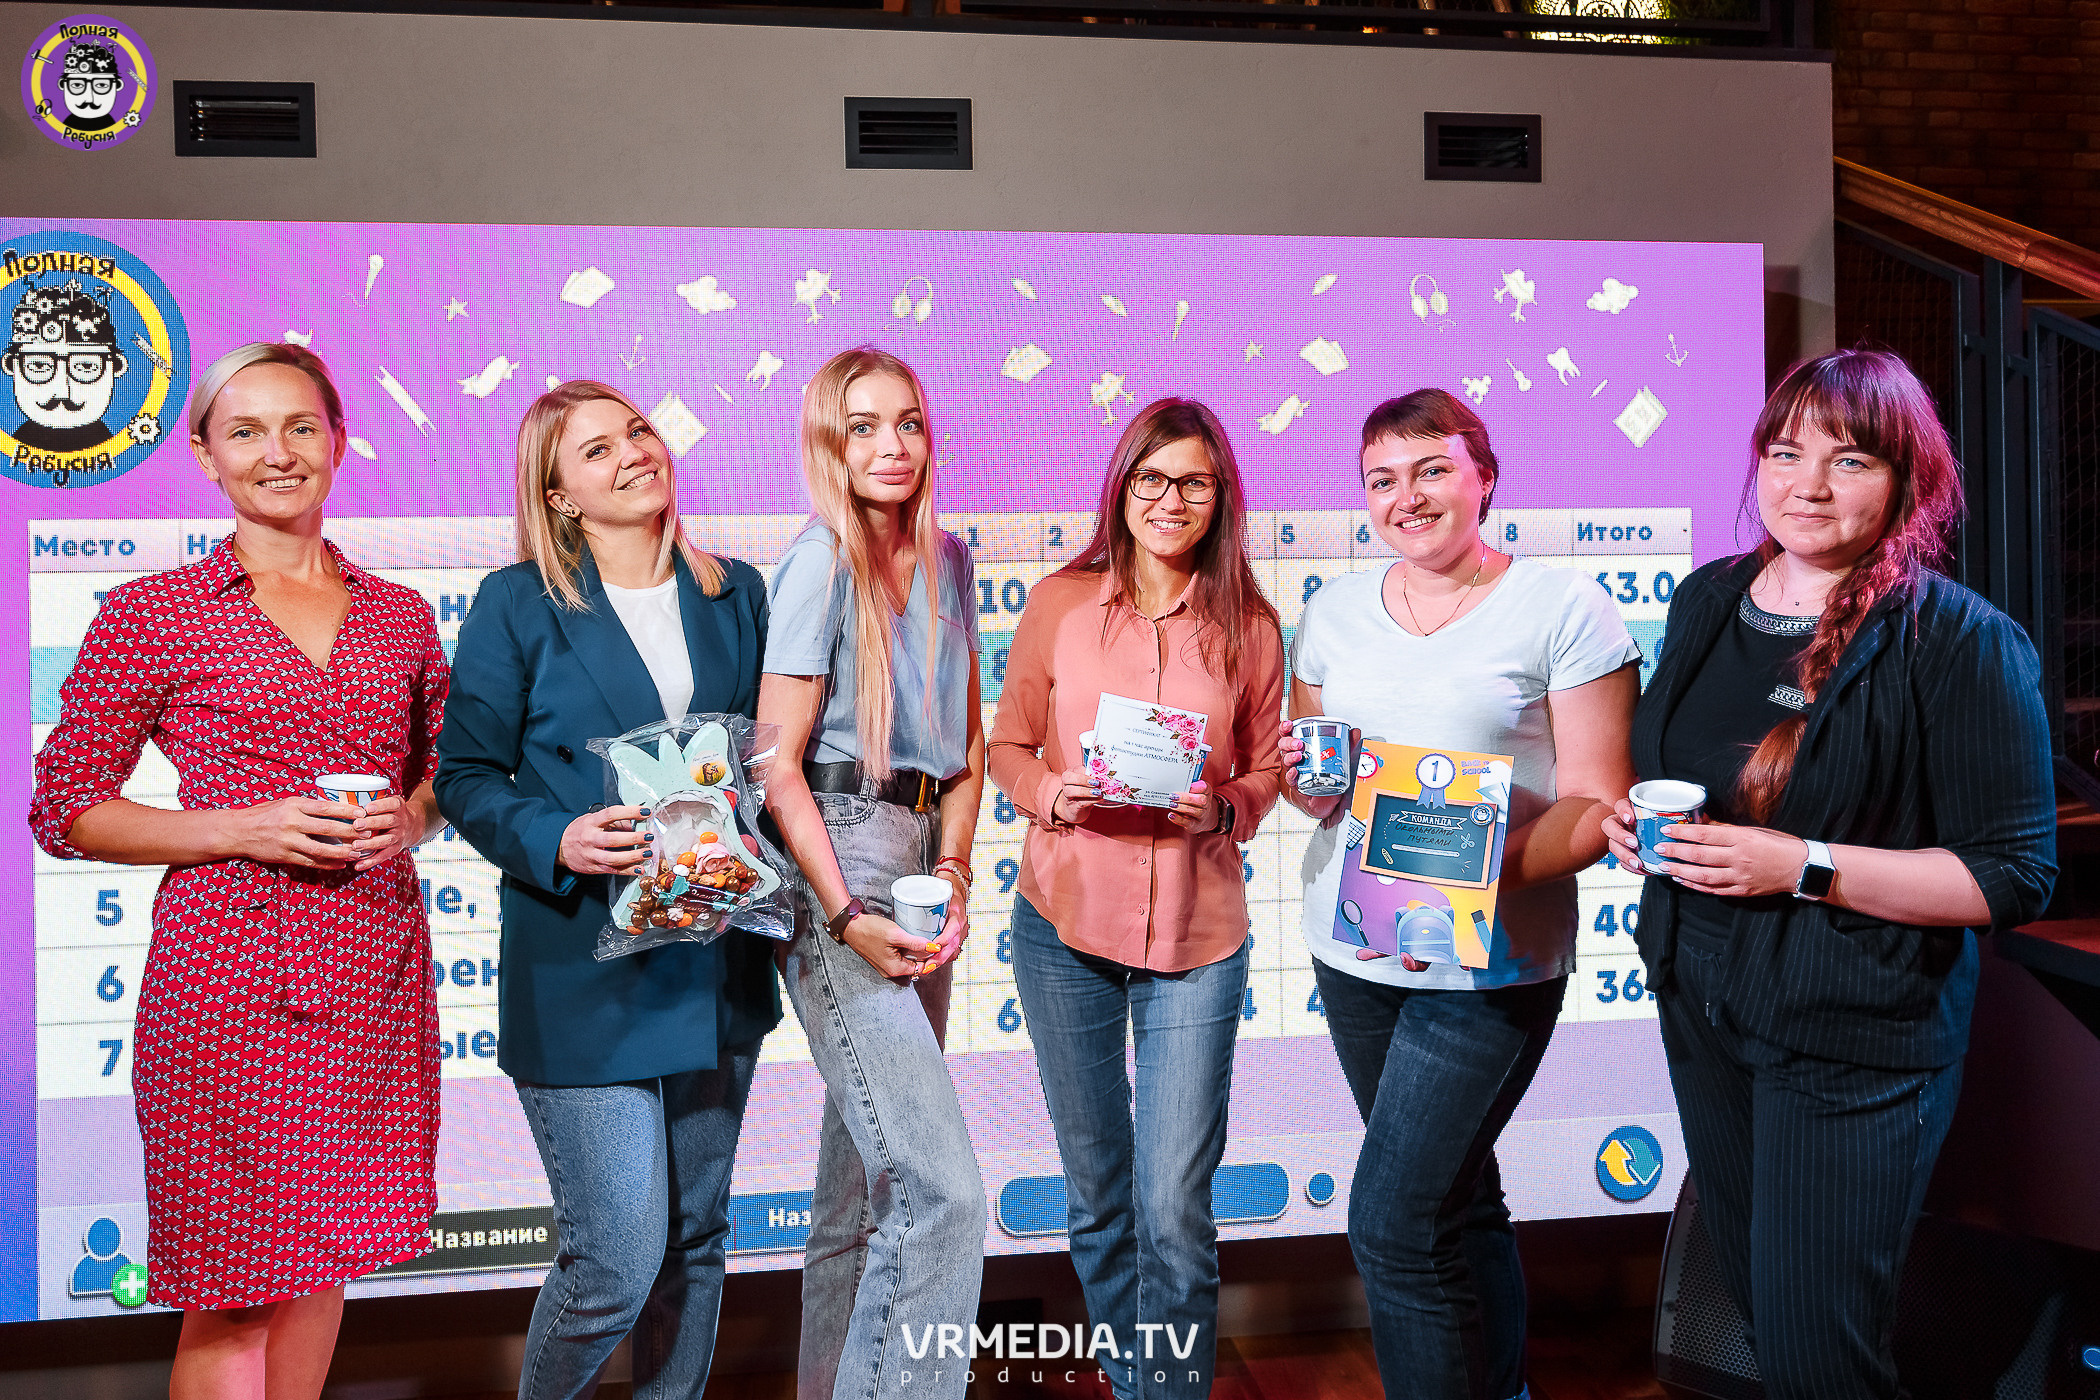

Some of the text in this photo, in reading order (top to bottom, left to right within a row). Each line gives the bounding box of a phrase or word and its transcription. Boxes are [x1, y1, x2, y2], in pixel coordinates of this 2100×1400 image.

[3, 248, 116, 280] Полная
[10, 444, 116, 487] Ребусня
[34, 535, 135, 556] Место
[968, 522, 1653, 547] 1 2 5 6 8 Итого
[978, 578, 1026, 615] 10
[1431, 760, 1440, 782] 1
[1462, 767, 1491, 775] SCHOOL
[1411, 815, 1452, 826] КОМАНДА
[995, 858, 1019, 893] 9
[95, 889, 123, 926] 5
[97, 965, 125, 1003] 6
[997, 998, 1022, 1033] 6
[99, 1040, 122, 1077] 7
[429, 1227, 549, 1249] Название
